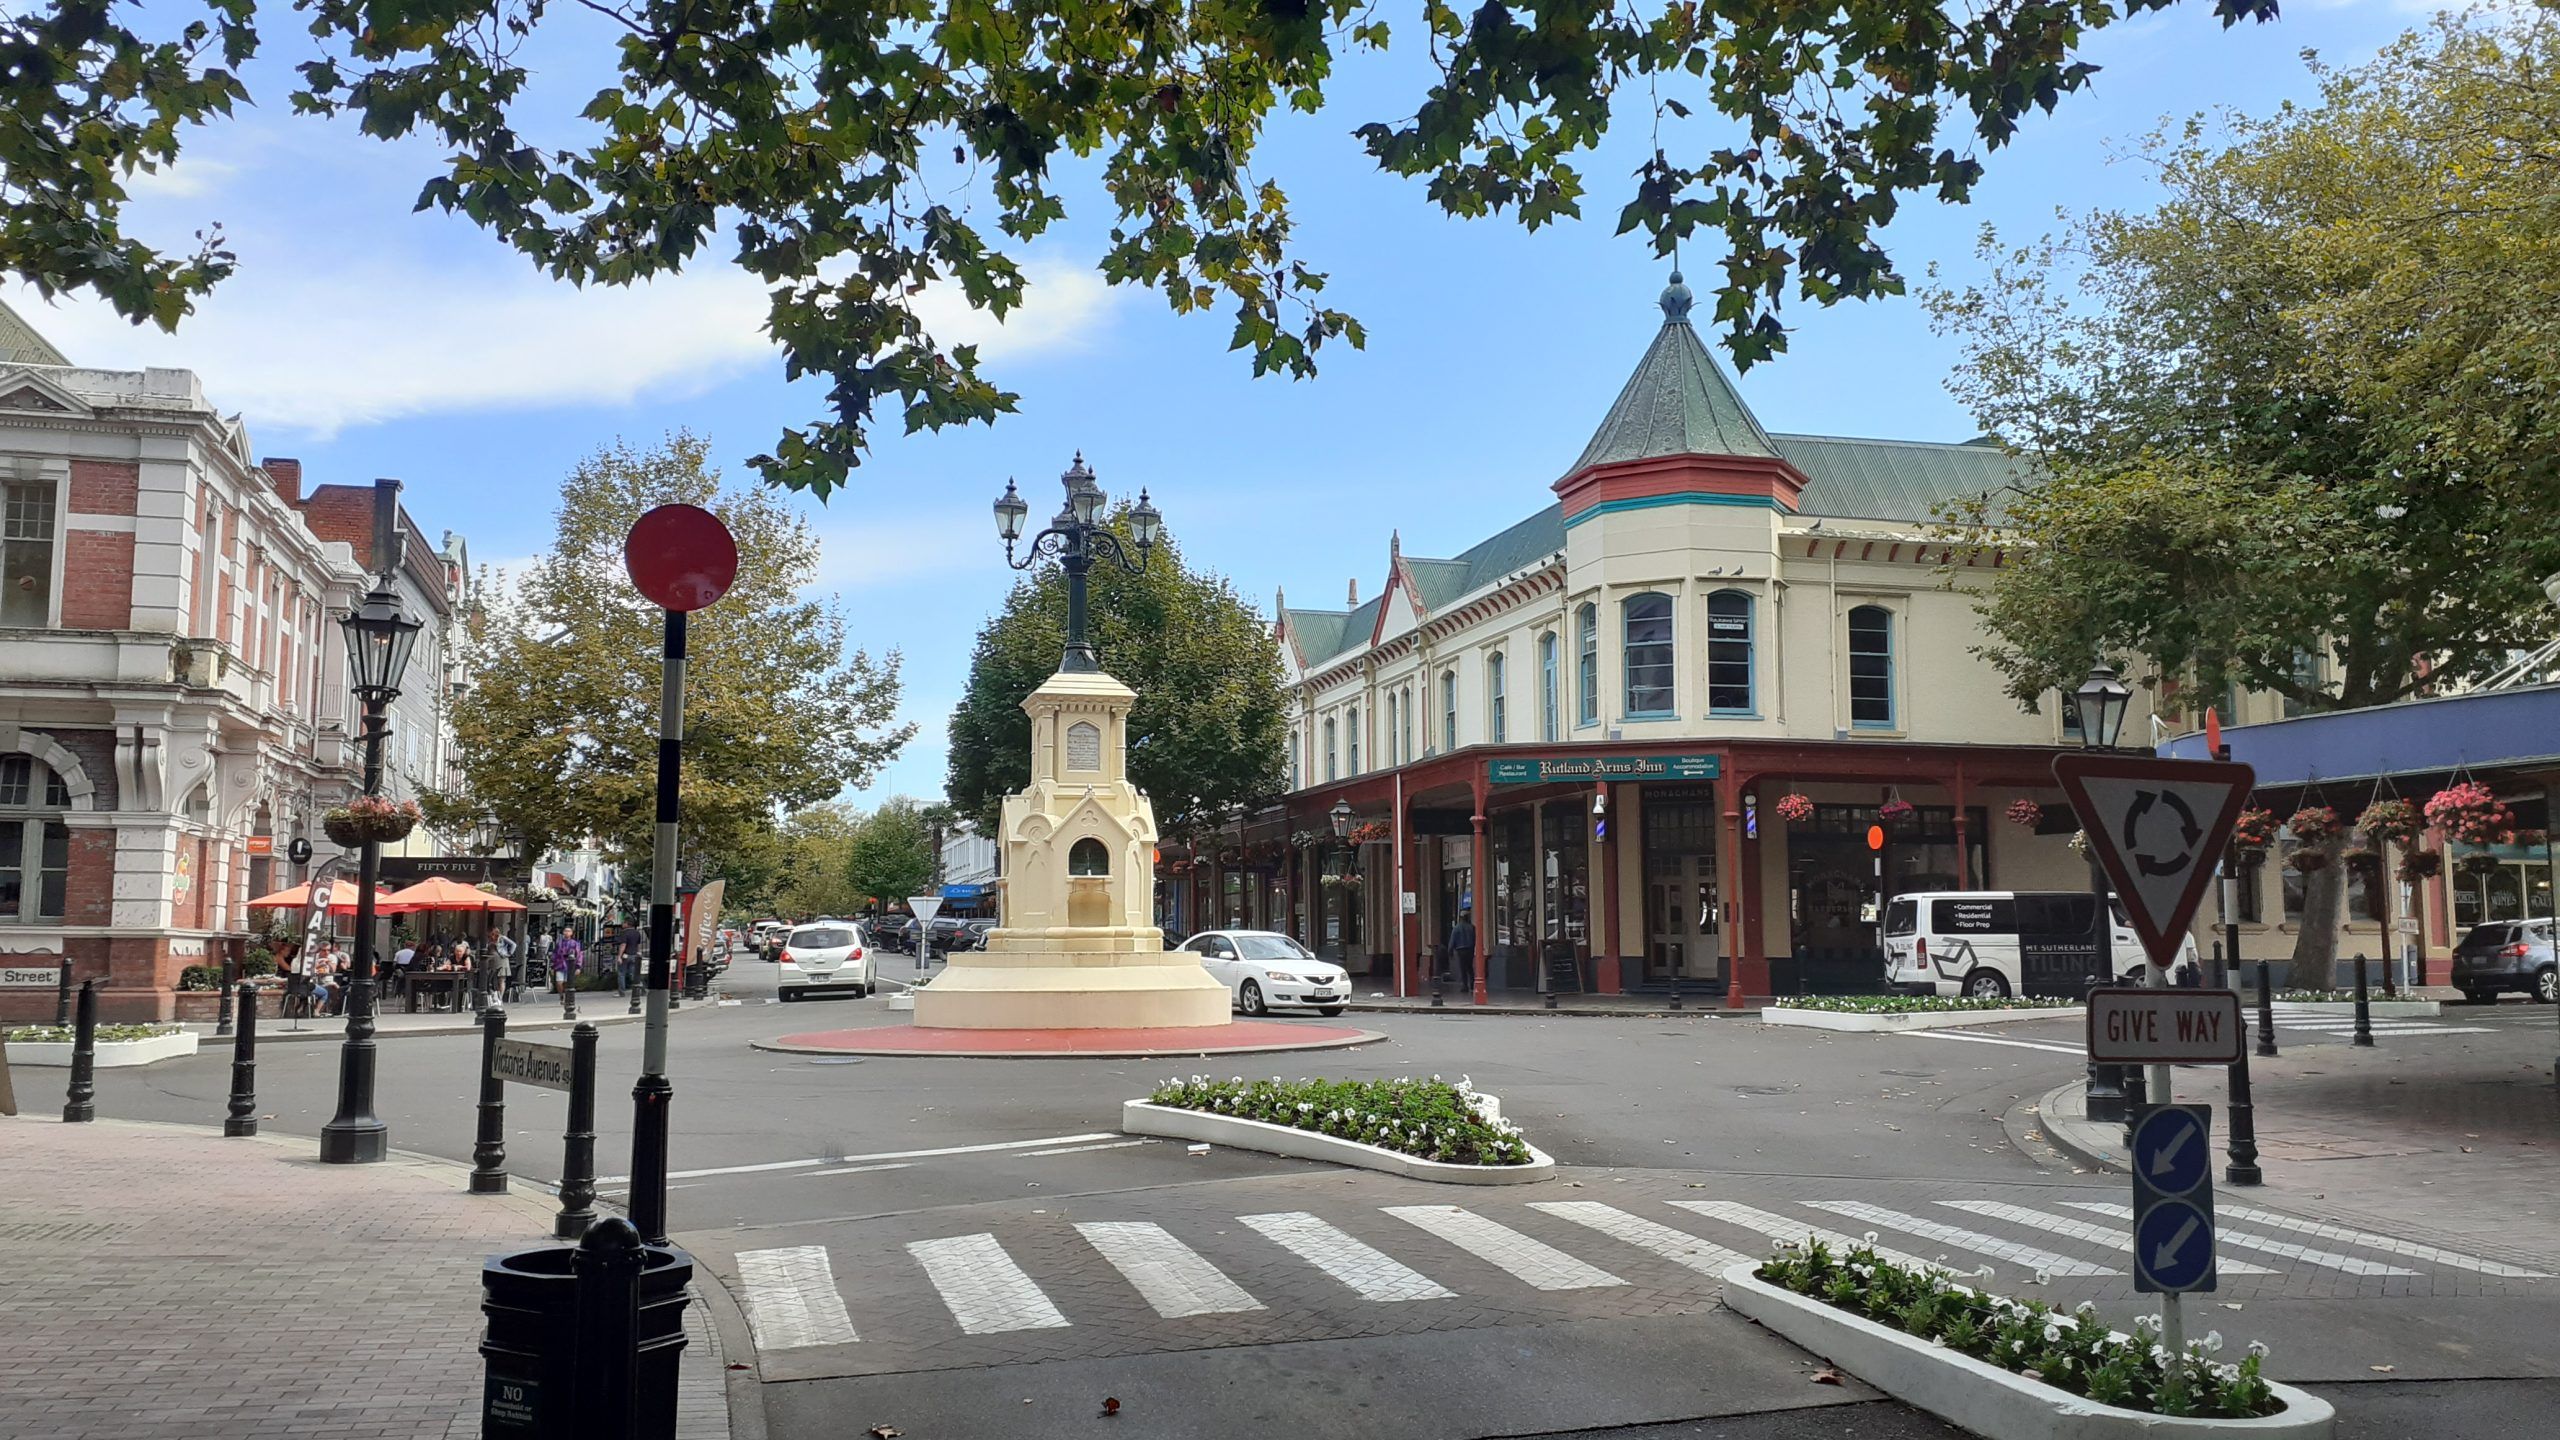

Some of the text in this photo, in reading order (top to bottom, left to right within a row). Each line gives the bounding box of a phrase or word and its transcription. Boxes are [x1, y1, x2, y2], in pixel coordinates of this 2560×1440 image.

[1540, 759, 1663, 778] Rutland Arms Inn
[417, 863, 477, 871] FIFTY FIVE
[4, 970, 53, 982] Street
[2107, 1010, 2222, 1043] GIVE WAY
[493, 1045, 524, 1076] Victoria
[526, 1050, 561, 1083] Avenue
[502, 1385, 523, 1401] NO
